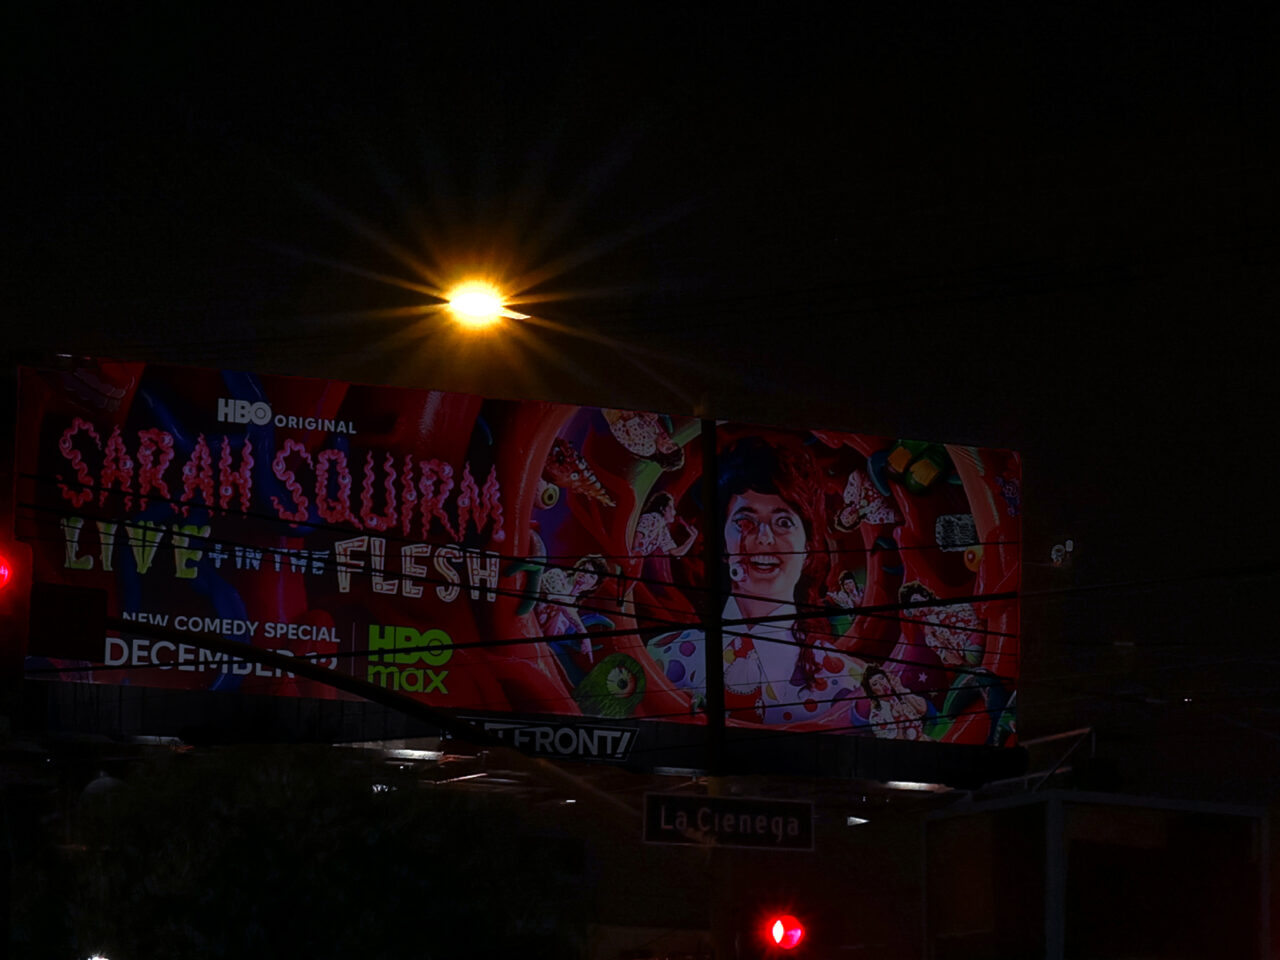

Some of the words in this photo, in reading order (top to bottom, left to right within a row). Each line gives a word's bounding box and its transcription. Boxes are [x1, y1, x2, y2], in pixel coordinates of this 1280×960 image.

[217, 398, 272, 426] HBO
[274, 415, 357, 435] ORIGINAL
[57, 416, 255, 519] SARAH
[271, 437, 507, 542] SQUIRM
[60, 516, 212, 579] LIVE
[234, 546, 263, 571] IN
[273, 548, 331, 577] THE
[334, 535, 501, 604] FLESH
[122, 611, 169, 628] NEW
[174, 615, 259, 638] COMEDY
[263, 620, 342, 643] SPECIAL
[367, 624, 454, 666] HBO
[367, 664, 449, 695] max
[660, 804, 689, 830] La
[697, 807, 801, 843] Cienega
